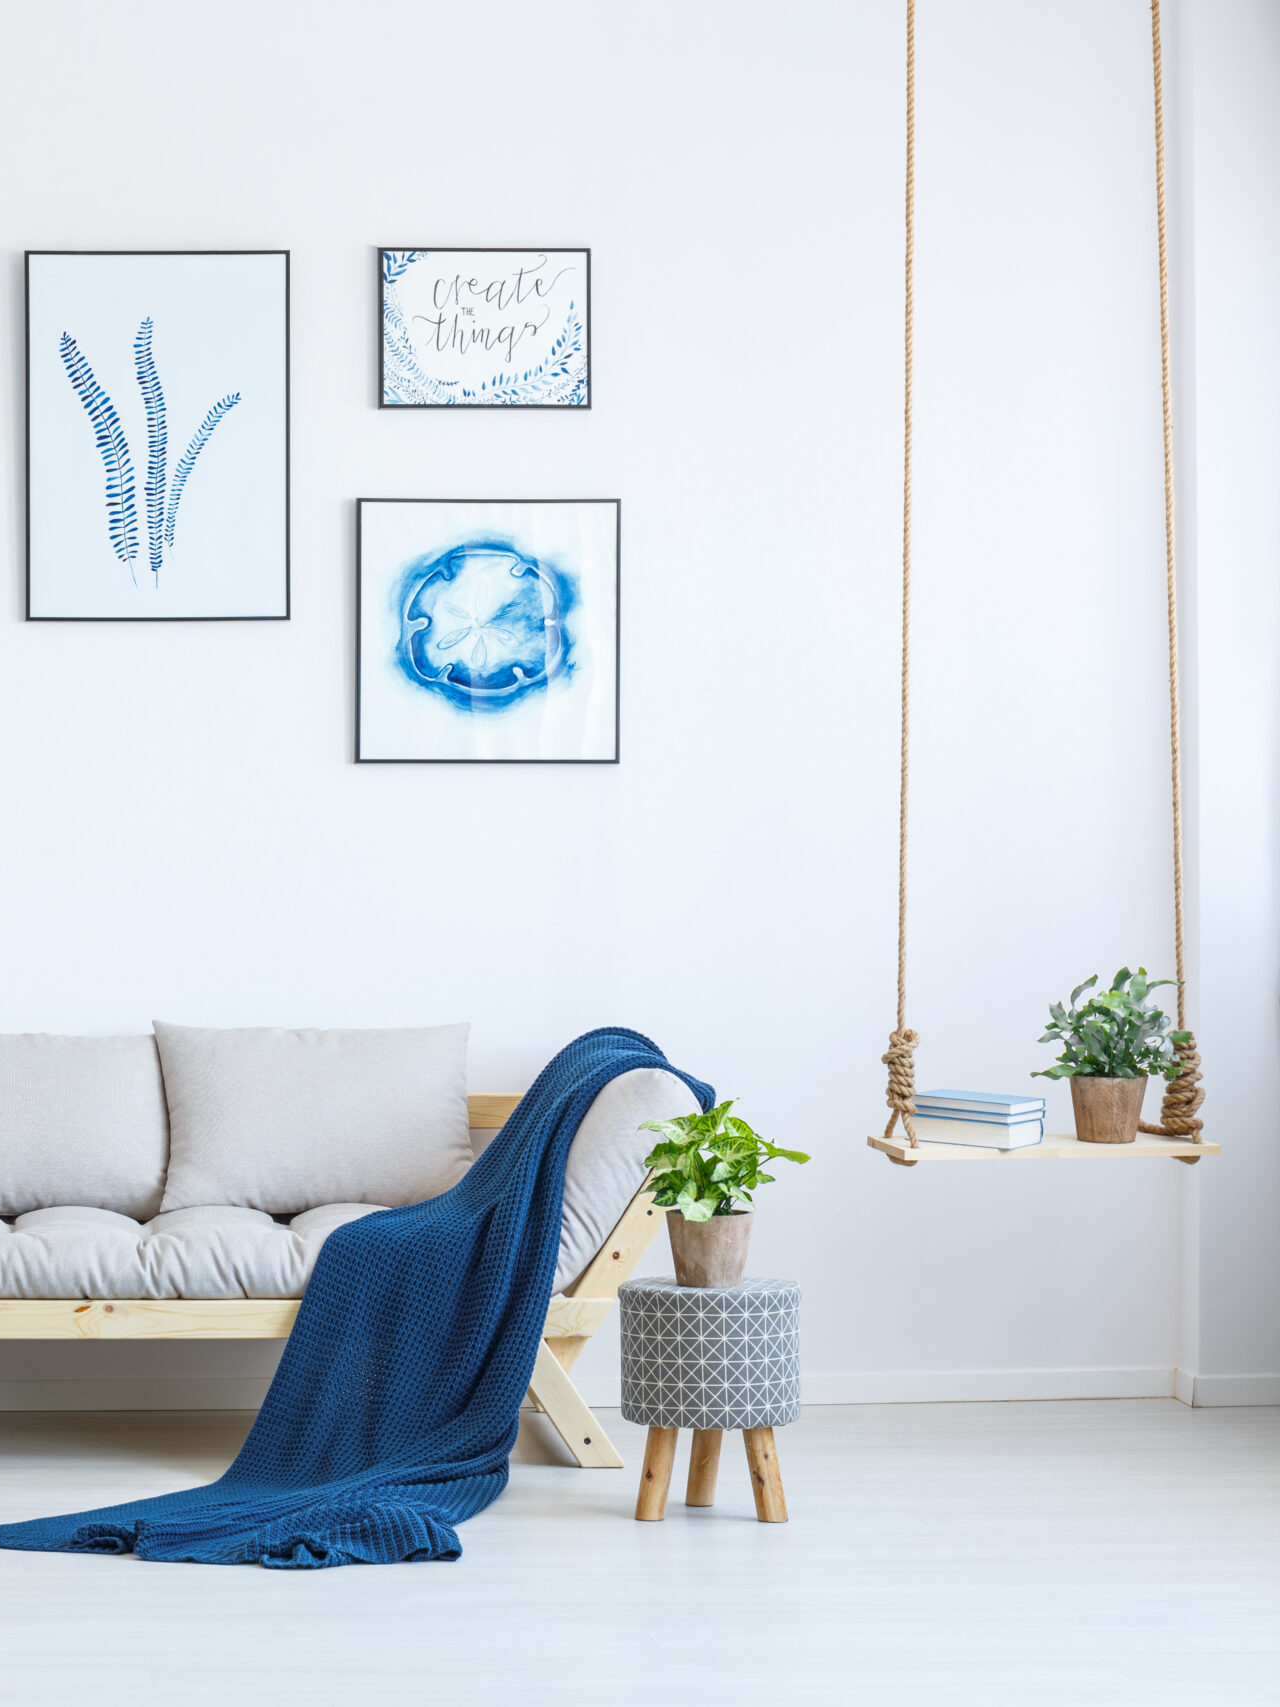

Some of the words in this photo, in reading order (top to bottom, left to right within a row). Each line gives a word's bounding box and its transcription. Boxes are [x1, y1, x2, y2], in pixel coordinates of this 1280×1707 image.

[433, 254, 576, 311] create
[412, 304, 550, 363] things
[461, 306, 475, 317] THE
